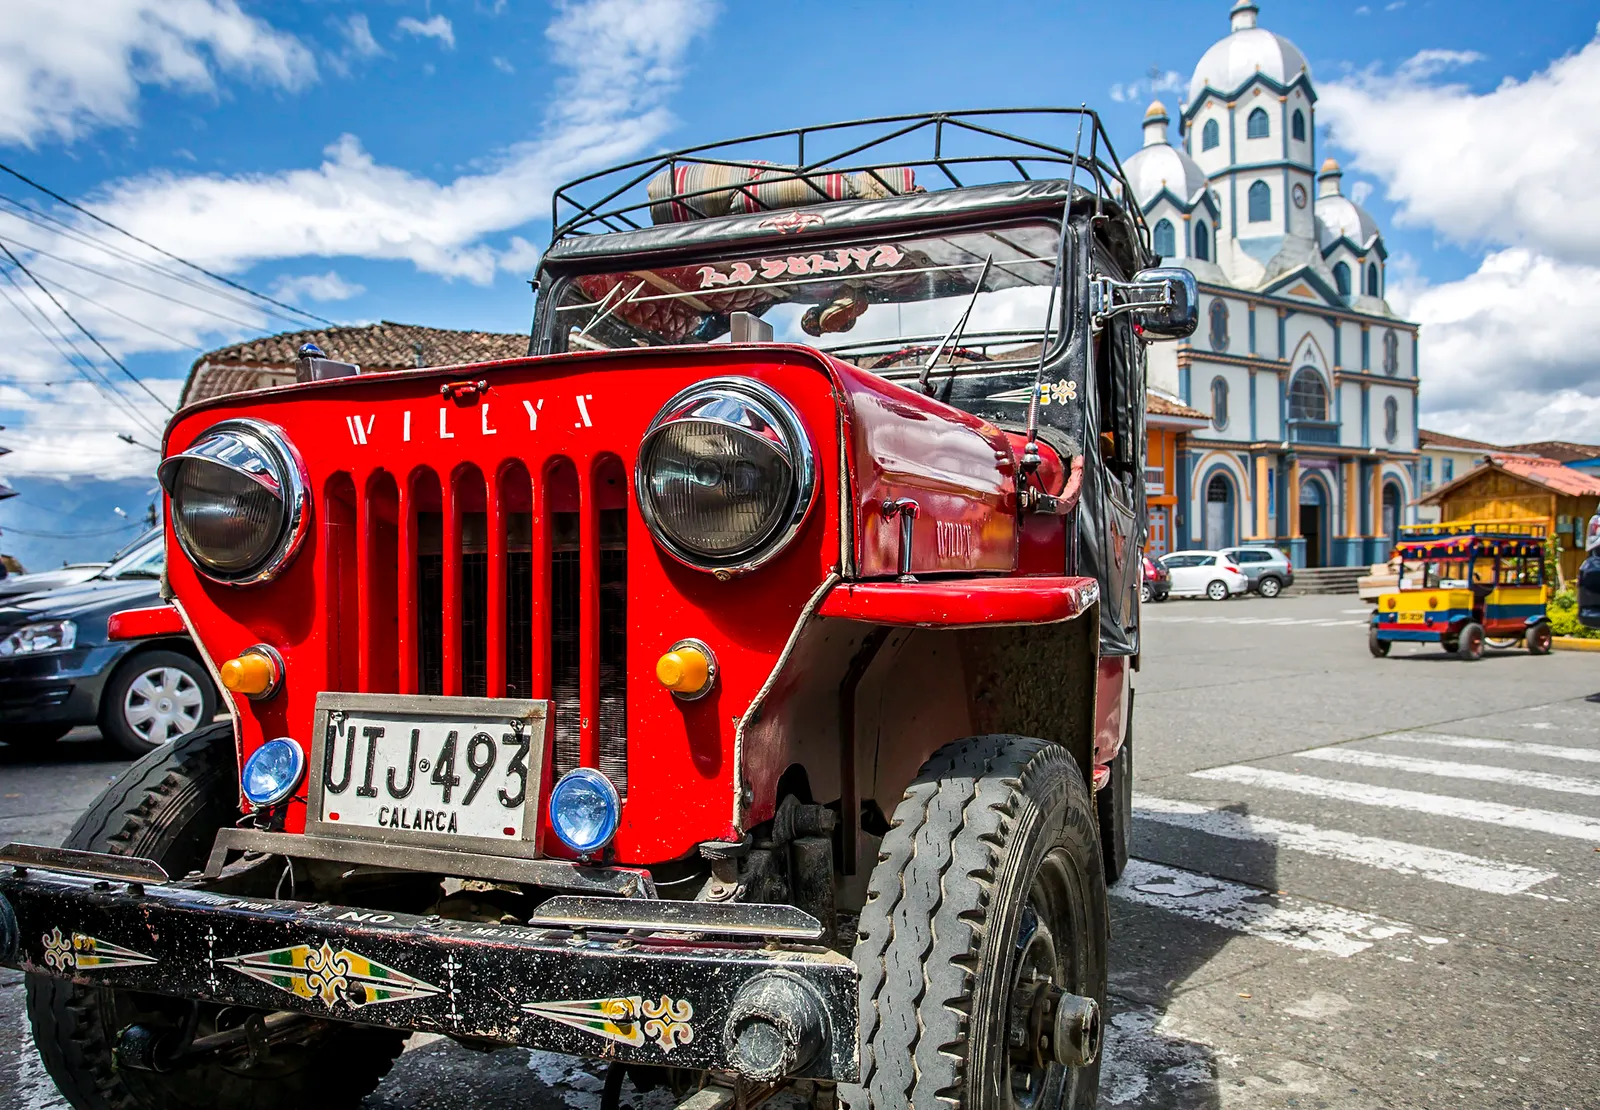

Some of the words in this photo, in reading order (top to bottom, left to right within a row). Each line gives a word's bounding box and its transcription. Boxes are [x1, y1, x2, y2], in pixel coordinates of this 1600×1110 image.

[346, 394, 593, 445] WILLYS
[430, 730, 531, 808] 493
[378, 805, 458, 833] CALARCA
[336, 911, 395, 923] NO
